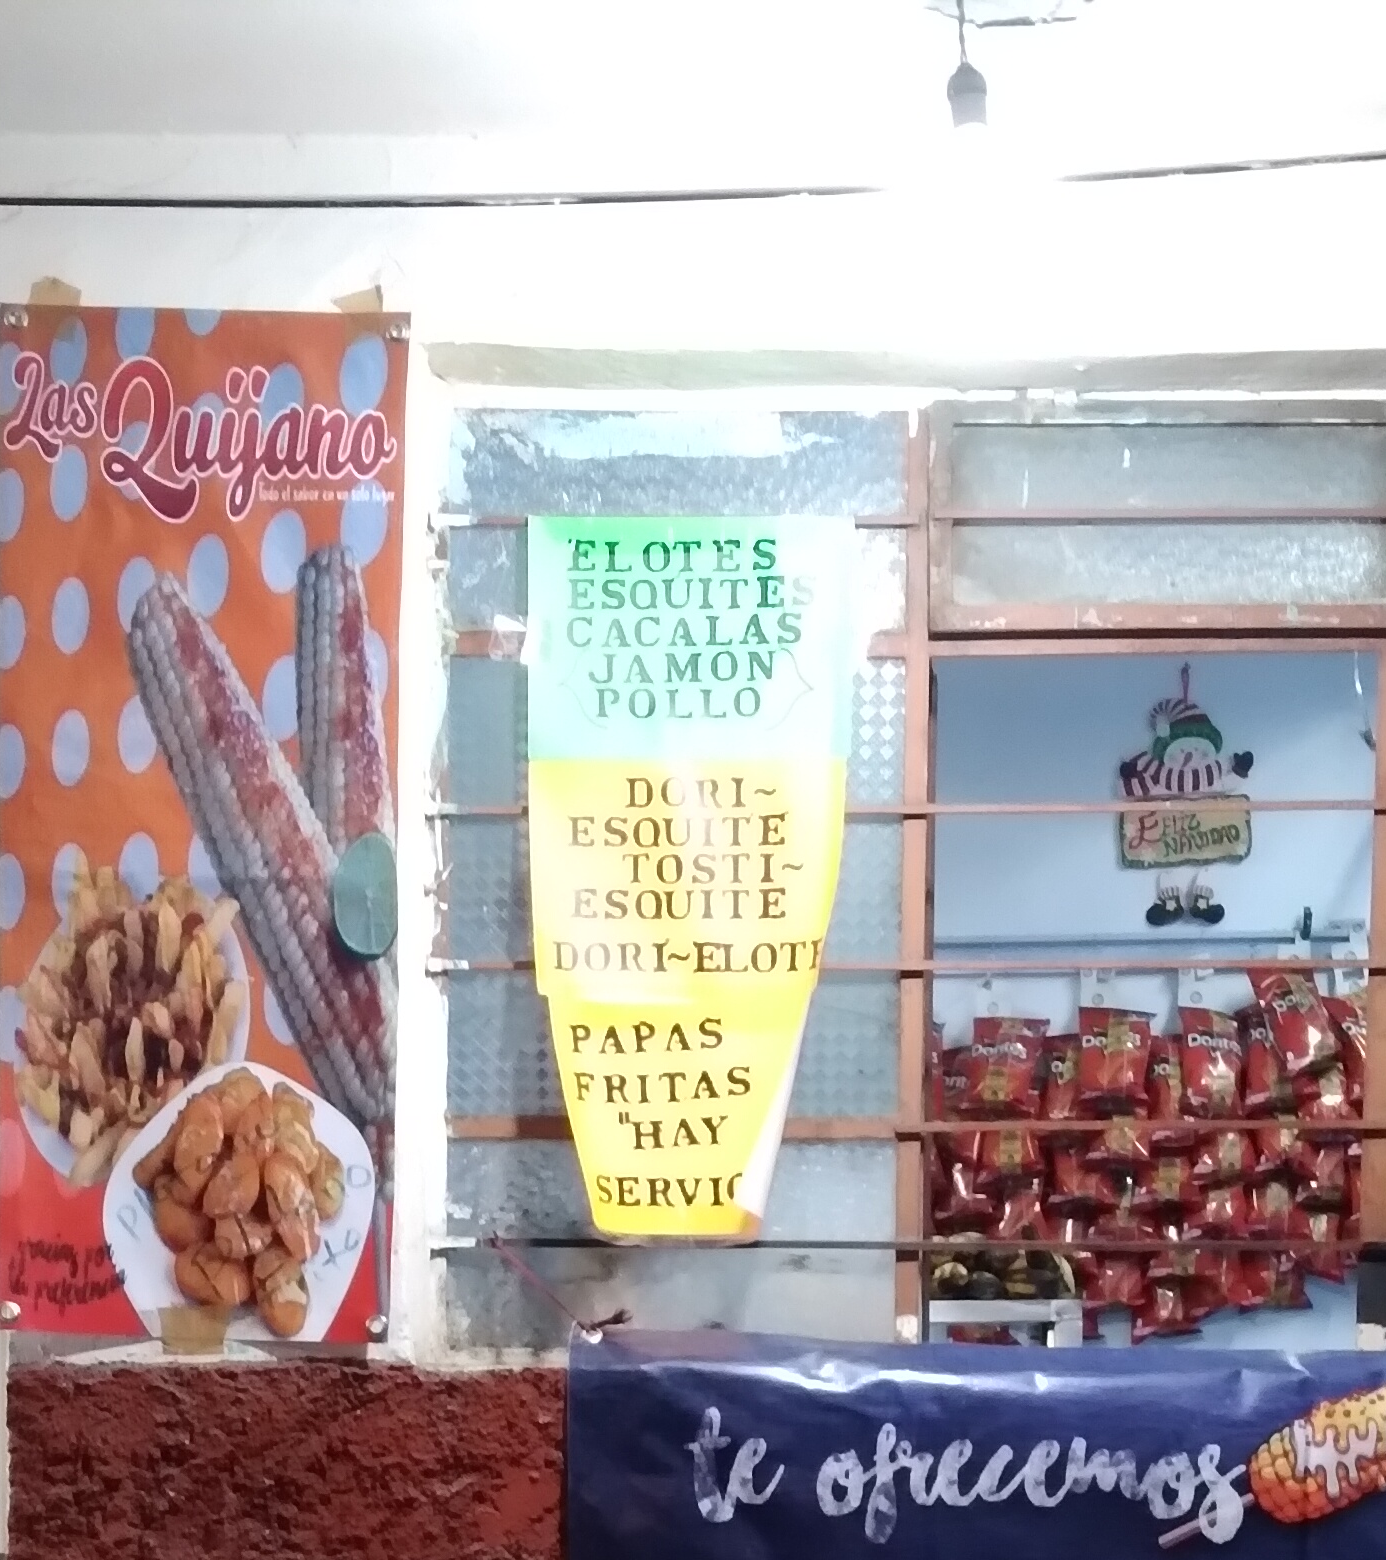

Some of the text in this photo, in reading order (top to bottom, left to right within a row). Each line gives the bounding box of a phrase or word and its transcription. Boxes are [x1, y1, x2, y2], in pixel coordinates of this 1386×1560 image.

[5, 351, 397, 523] Las Quijano
[567, 538, 778, 573] ELOTES
[567, 574, 816, 611] ESQUITES
[566, 612, 803, 648] CACALAS
[588, 650, 777, 685] JAMON
[594, 687, 762, 719] POLLO
[567, 811, 789, 848] ESQUITE
[570, 887, 787, 920] ESQUITE
[569, 1017, 724, 1056] PAPAS
[574, 1065, 752, 1105] FRITAS
[683, 1406, 1247, 1545] te ofrecemos
